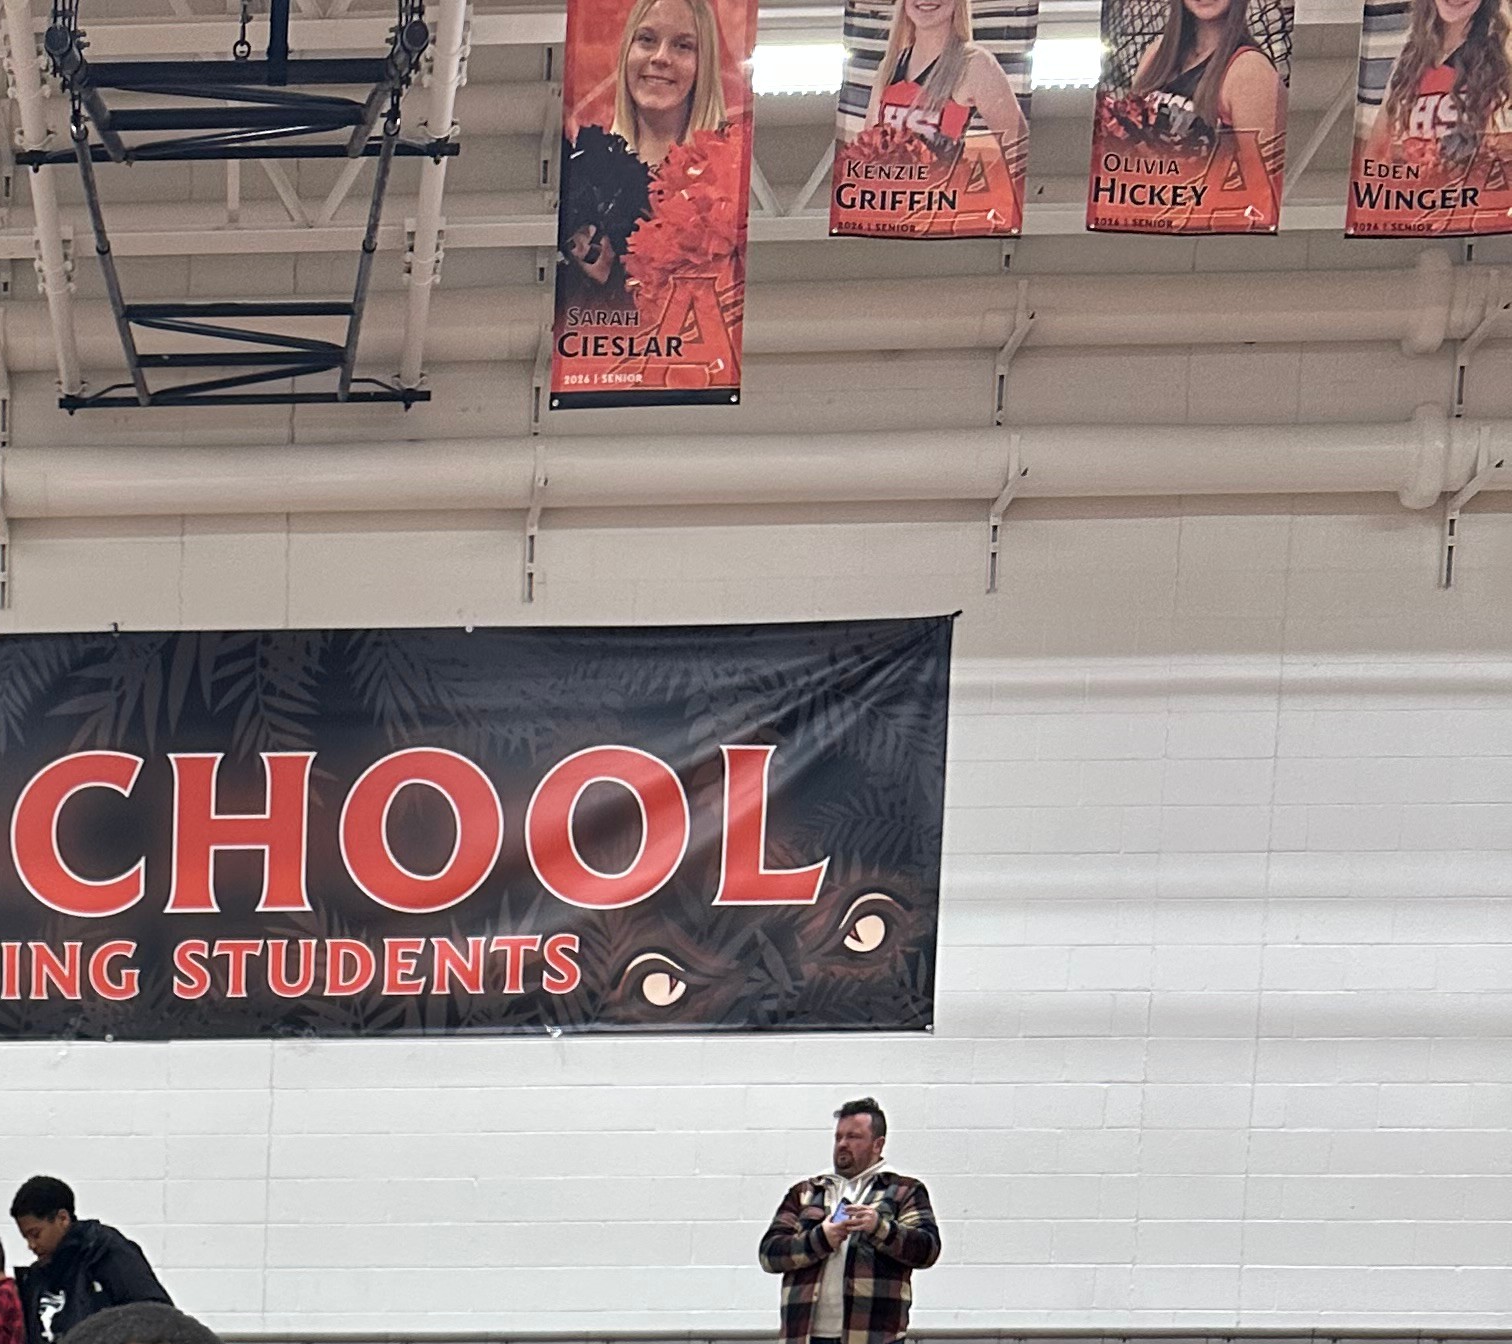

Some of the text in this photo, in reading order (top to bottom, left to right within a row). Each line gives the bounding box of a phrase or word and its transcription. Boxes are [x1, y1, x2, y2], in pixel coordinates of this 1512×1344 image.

[846, 161, 929, 181] KENZIE
[1104, 154, 1180, 175] OLIVIA
[1364, 159, 1420, 180] EDEN
[836, 183, 957, 210] GRIFFIN
[1093, 177, 1208, 206] HICKEY
[1353, 182, 1479, 210] WINGER
[567, 307, 639, 326] SARAH
[557, 331, 684, 358] CIESLAR
[173, 933, 581, 999] STUDENTS
